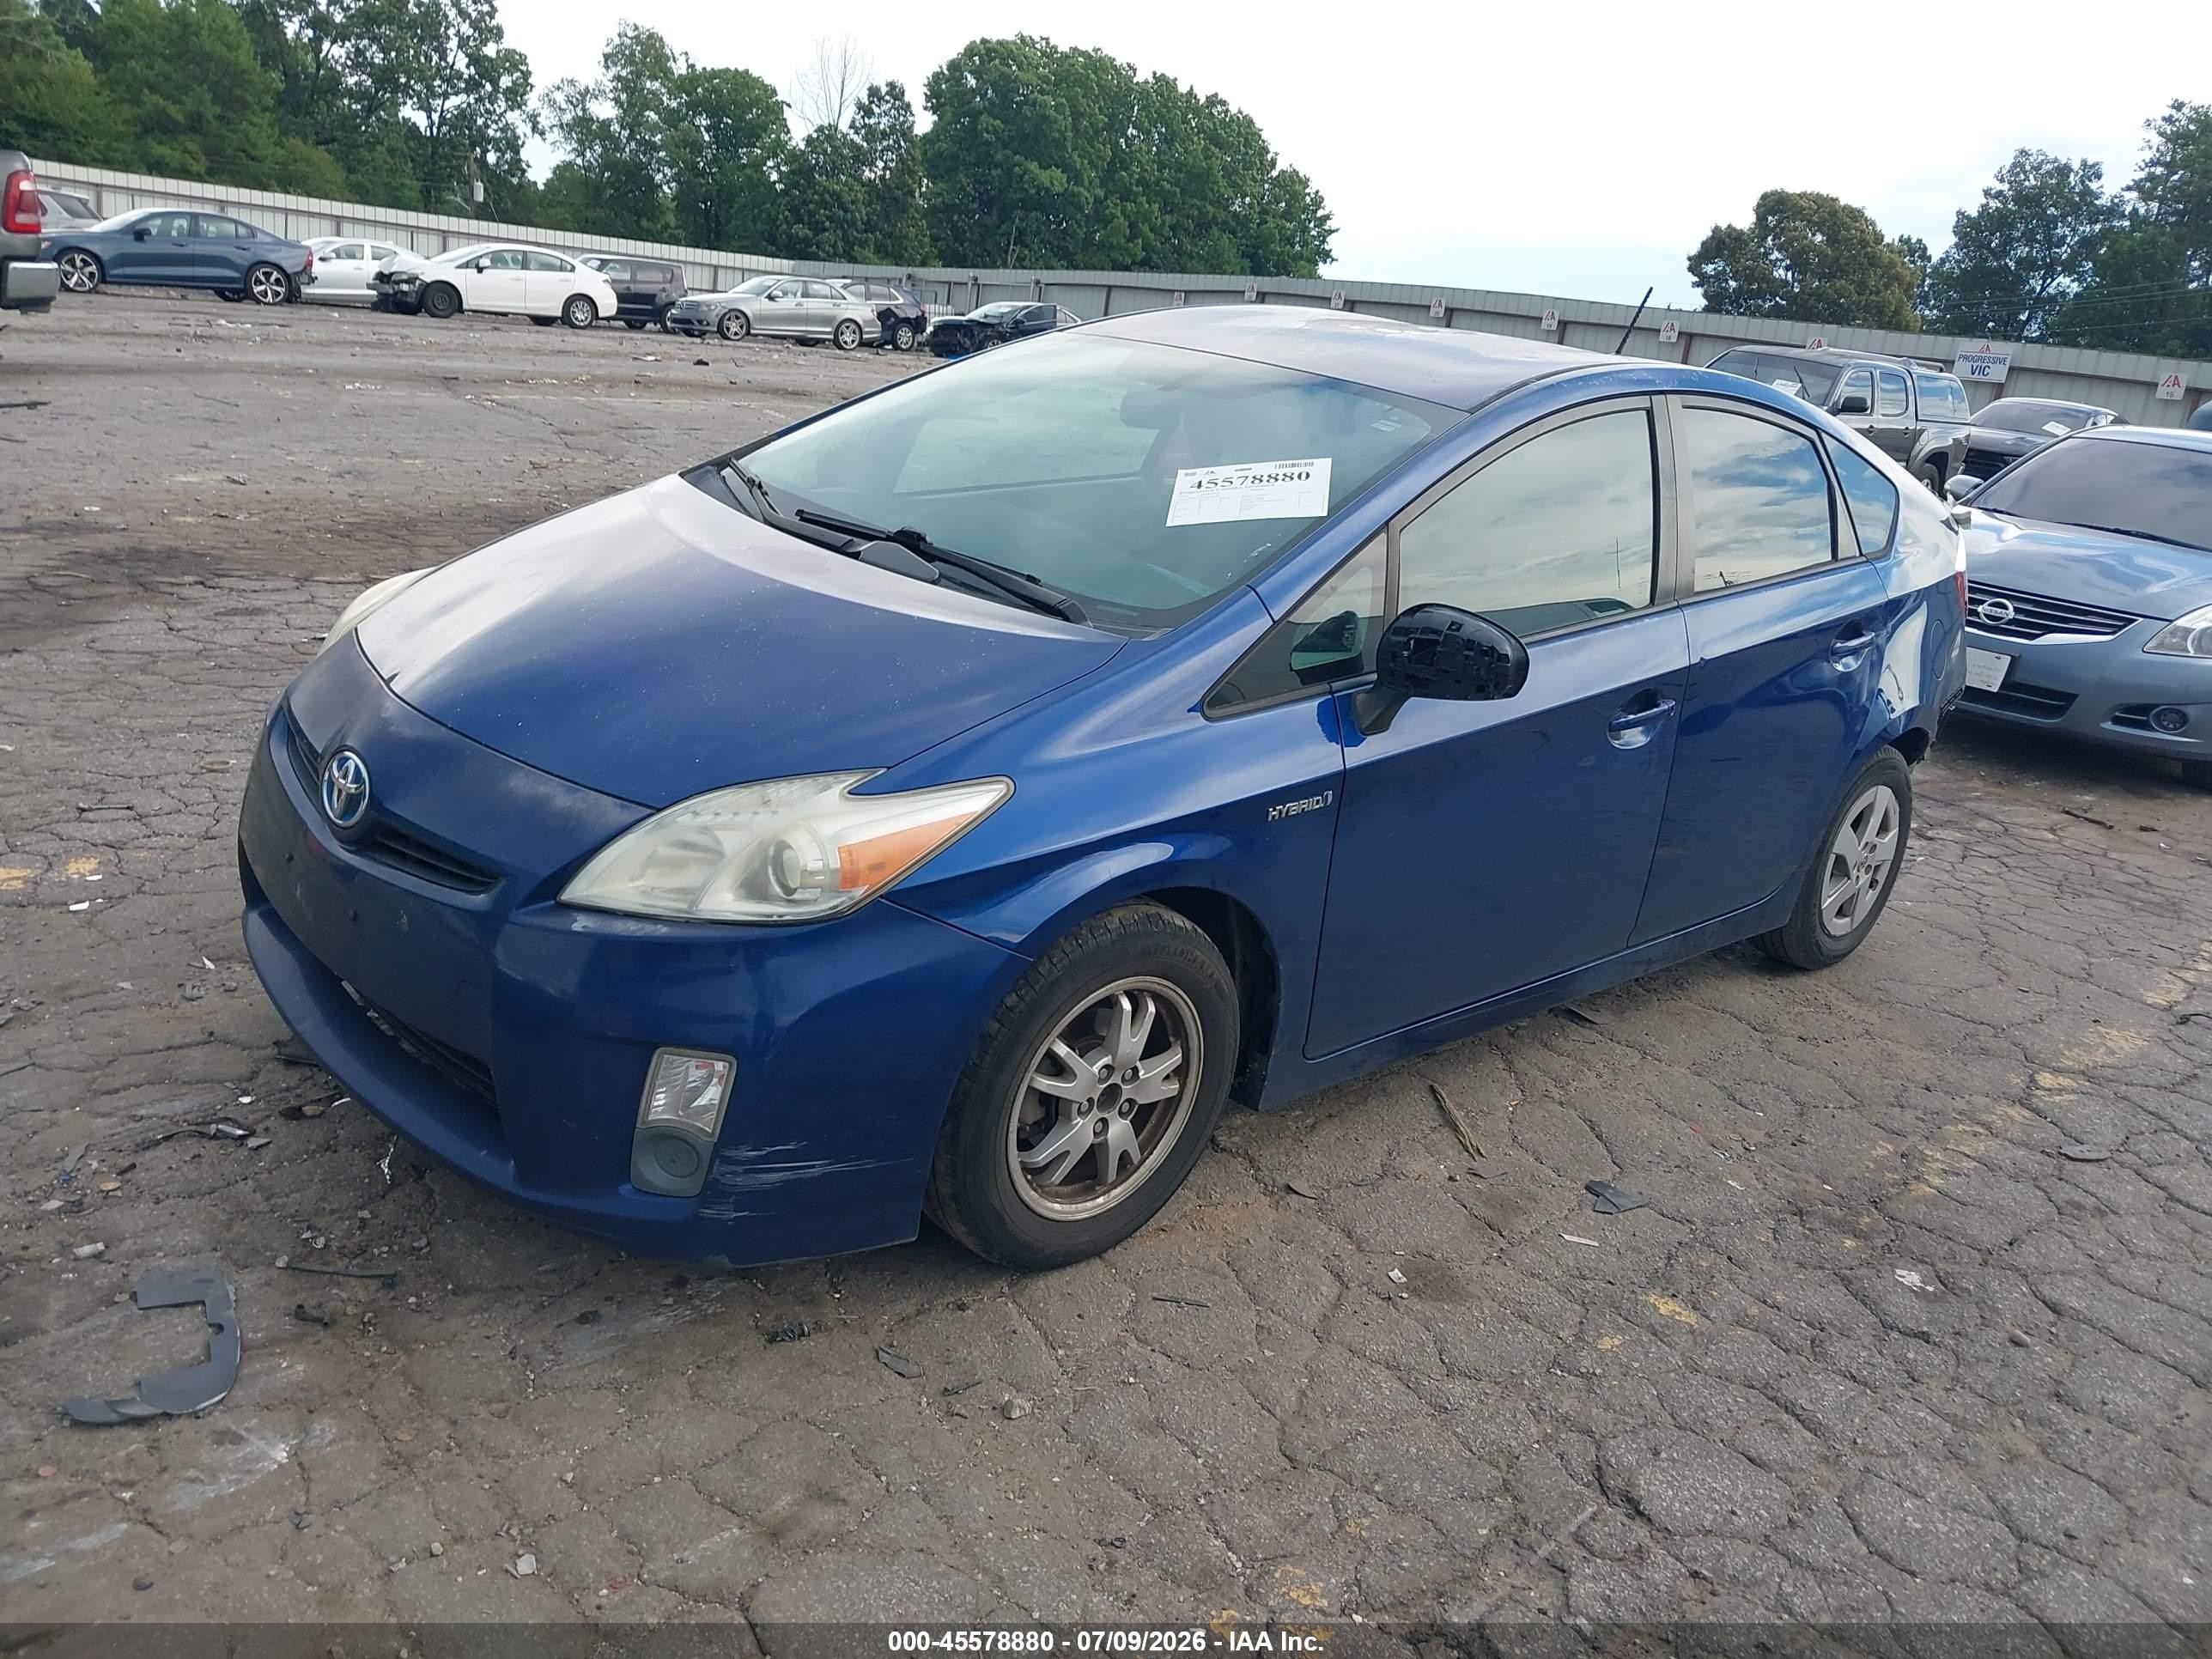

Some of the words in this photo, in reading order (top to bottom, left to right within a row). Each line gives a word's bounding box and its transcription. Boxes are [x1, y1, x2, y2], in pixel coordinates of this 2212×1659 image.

[1958, 354, 2008, 366] PROGRESSIVE
[1971, 364, 1990, 377] VIC
[1189, 471, 1311, 490] 45578880
[1981, 606, 2010, 617] NISSAN
[1267, 796, 1324, 822] HYBRID
